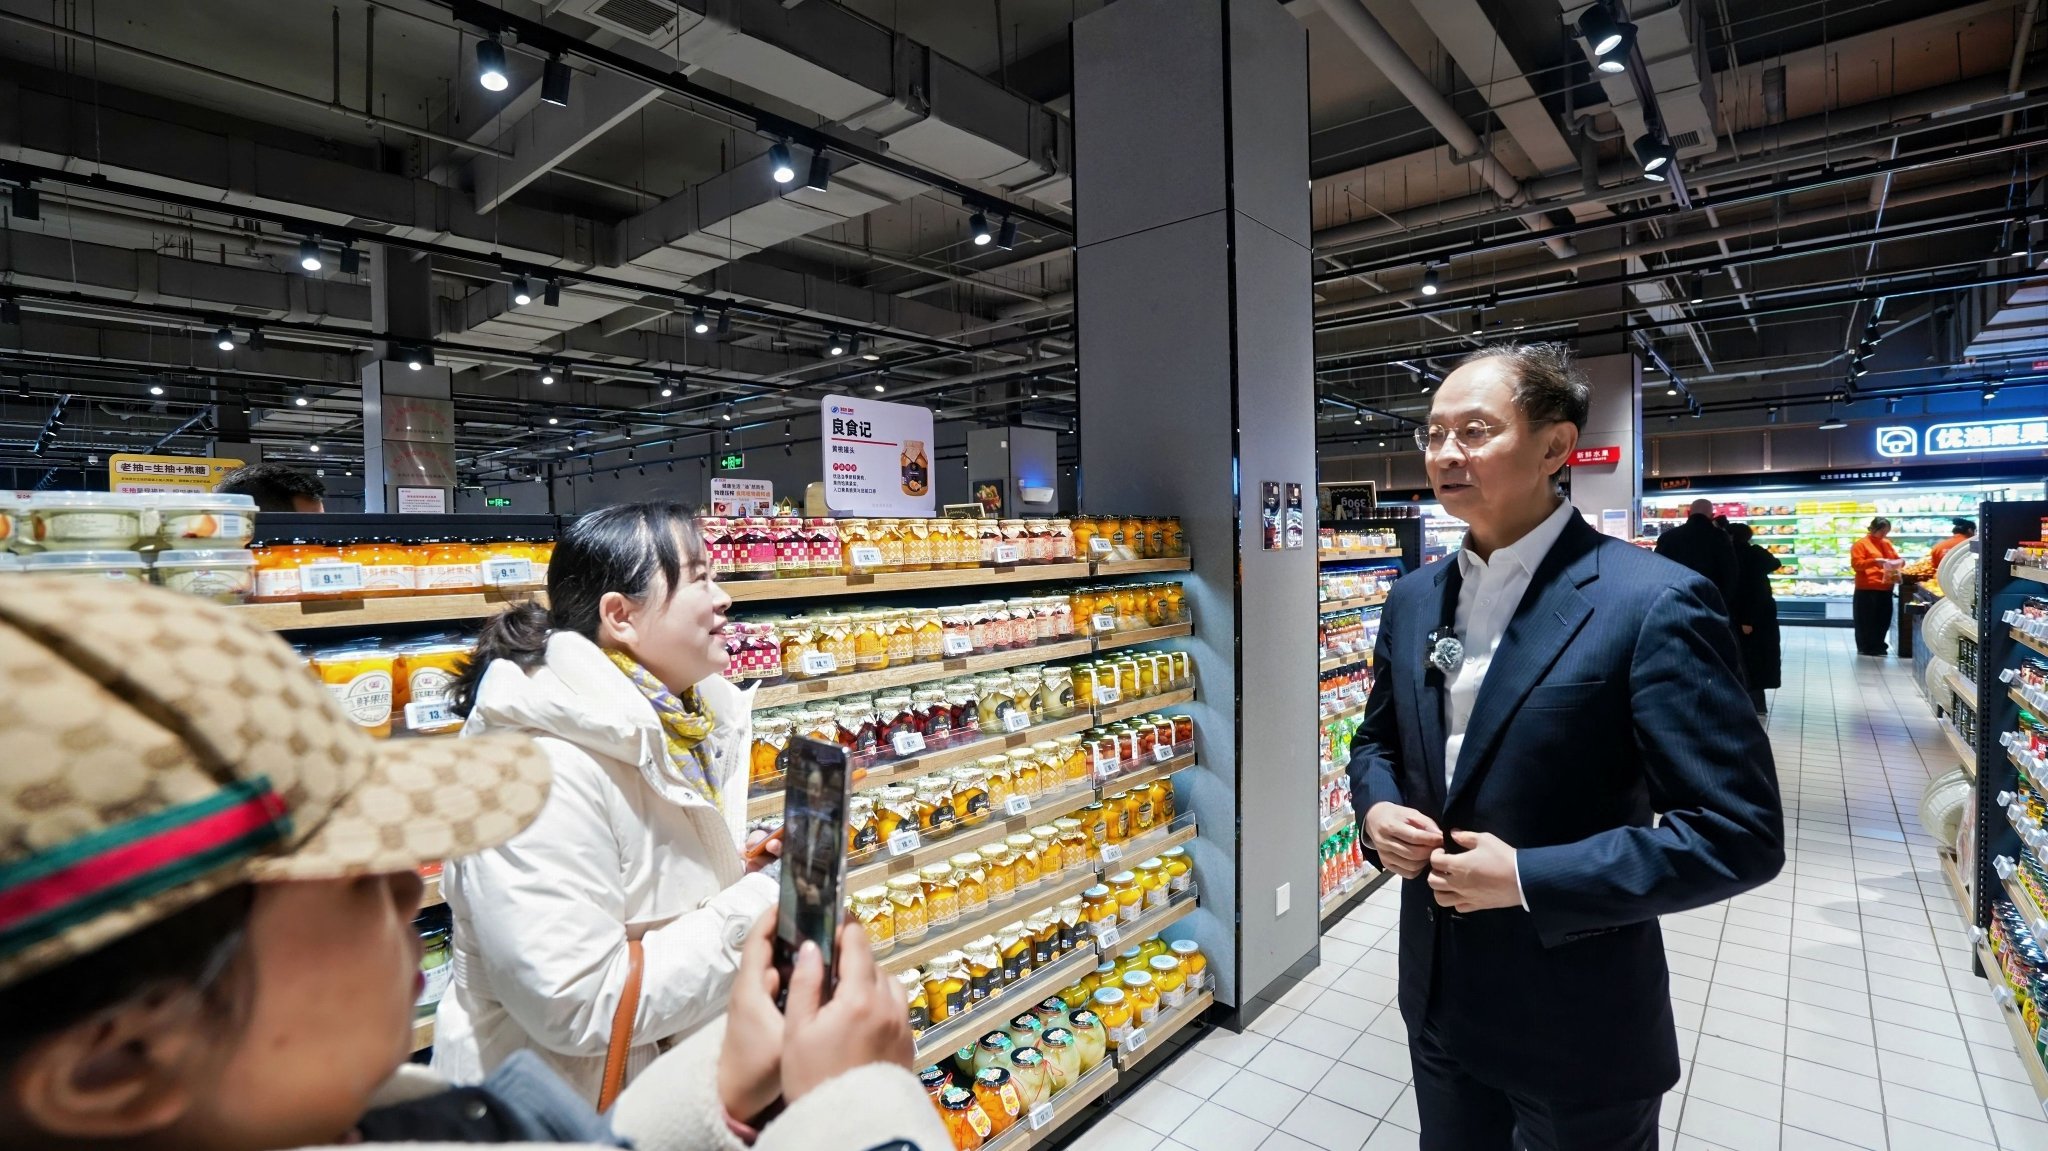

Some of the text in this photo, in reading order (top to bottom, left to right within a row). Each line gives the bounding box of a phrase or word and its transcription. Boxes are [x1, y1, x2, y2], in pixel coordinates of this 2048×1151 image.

[832, 418, 872, 438] 良食记
[832, 445, 855, 454] 黄桃罐头
[1576, 449, 1609, 459] 新鲜水果
[121, 462, 206, 475] 老抽=生抽+焦糖
